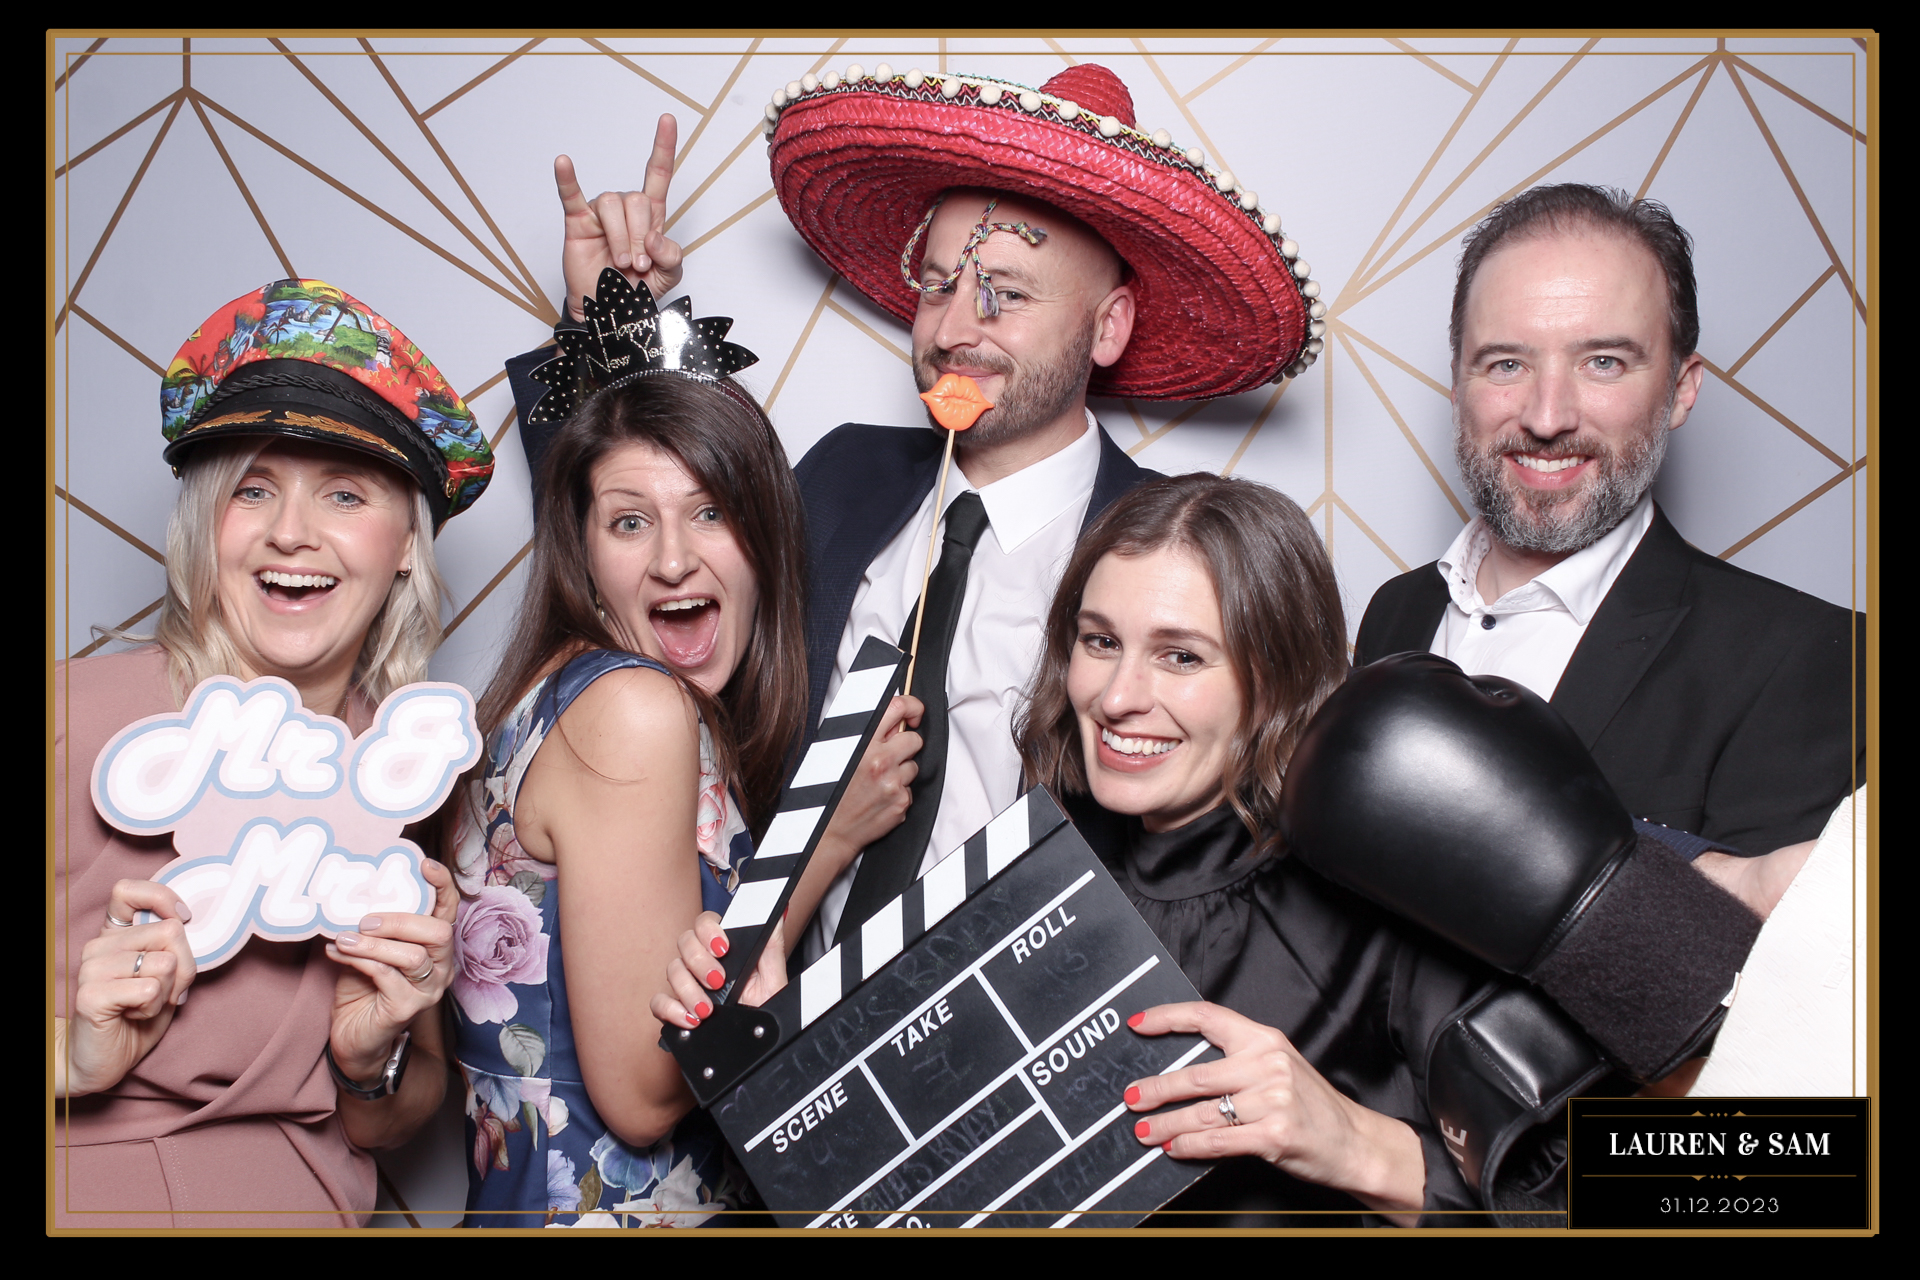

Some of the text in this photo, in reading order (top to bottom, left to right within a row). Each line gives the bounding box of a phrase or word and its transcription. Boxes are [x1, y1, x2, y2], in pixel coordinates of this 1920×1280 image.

[592, 311, 657, 345] Happy
[585, 347, 631, 379] New
[103, 686, 473, 824] Mr &
[145, 820, 425, 958] Mrs
[1011, 905, 1076, 964] ROLL
[891, 997, 954, 1057] TAKE
[1031, 1006, 1122, 1086] SOUND
[771, 1081, 849, 1154] SCENE
